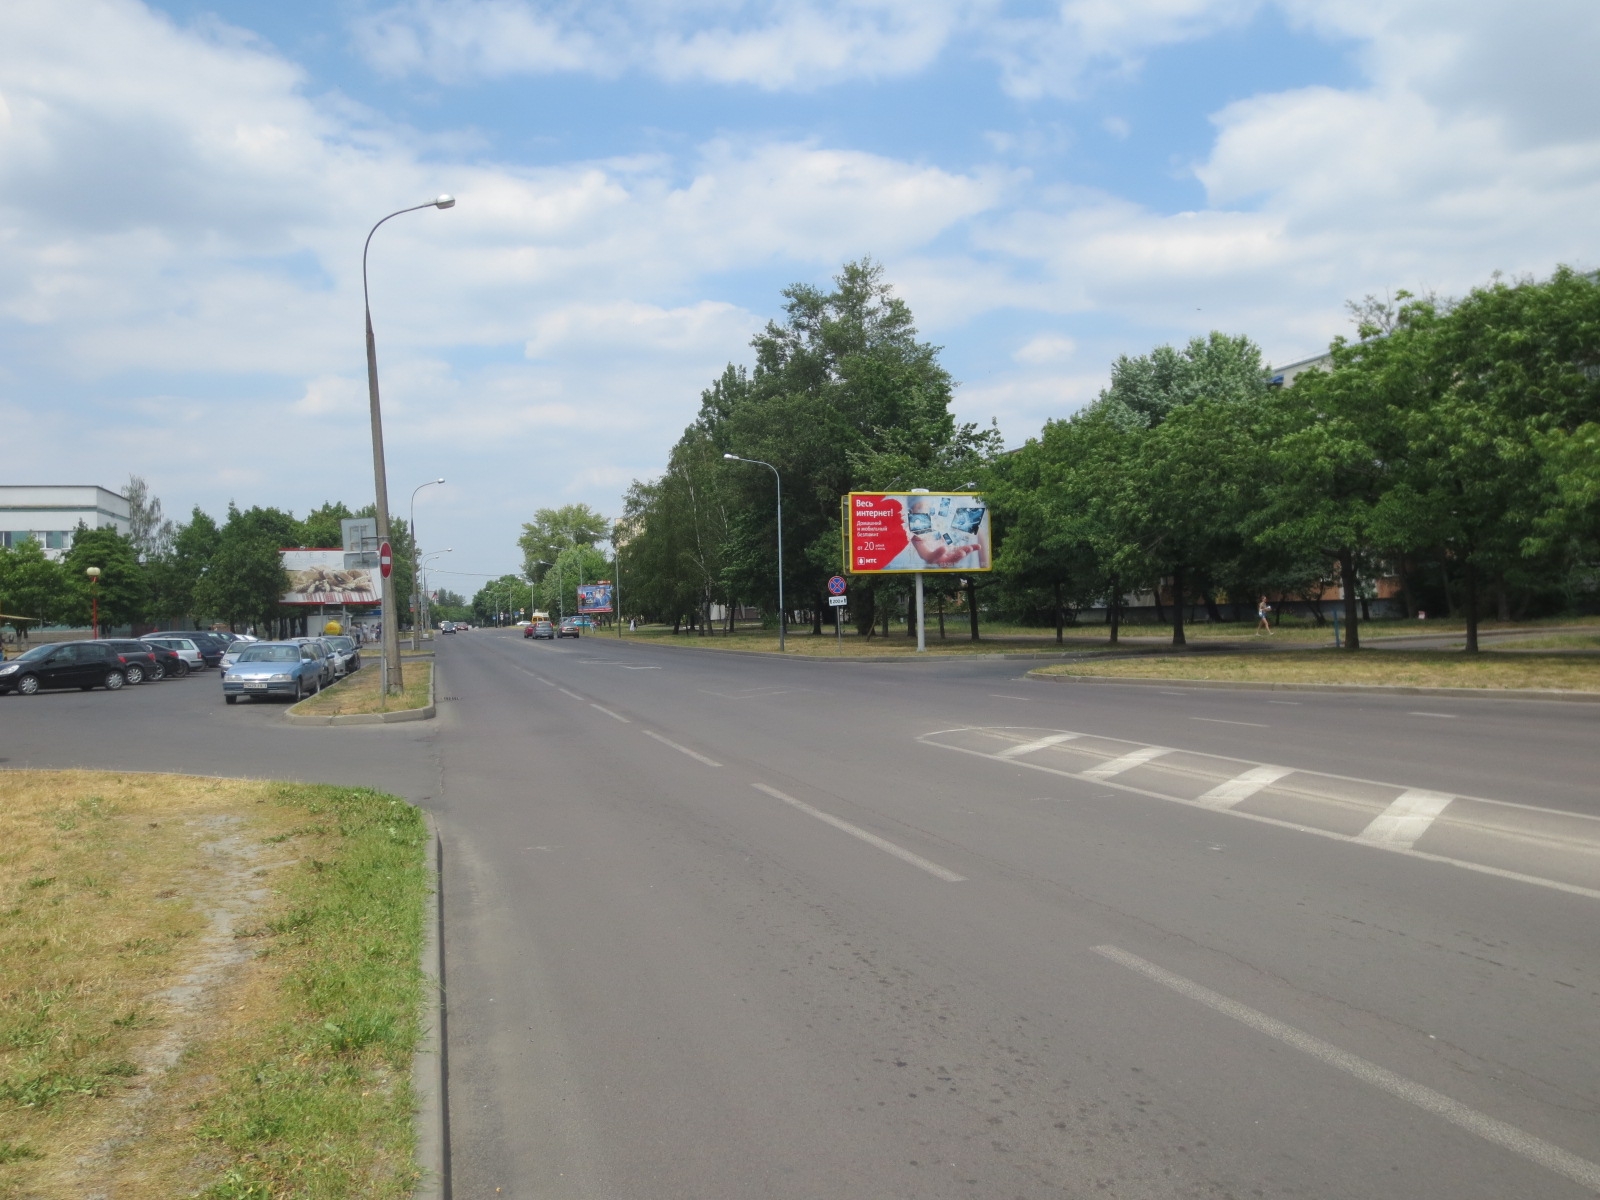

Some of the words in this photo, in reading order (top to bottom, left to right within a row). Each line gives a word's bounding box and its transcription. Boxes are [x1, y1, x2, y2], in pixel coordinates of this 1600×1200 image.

[856, 499, 874, 508] Весь
[856, 508, 894, 518] интернет!
[864, 541, 875, 551] 20
